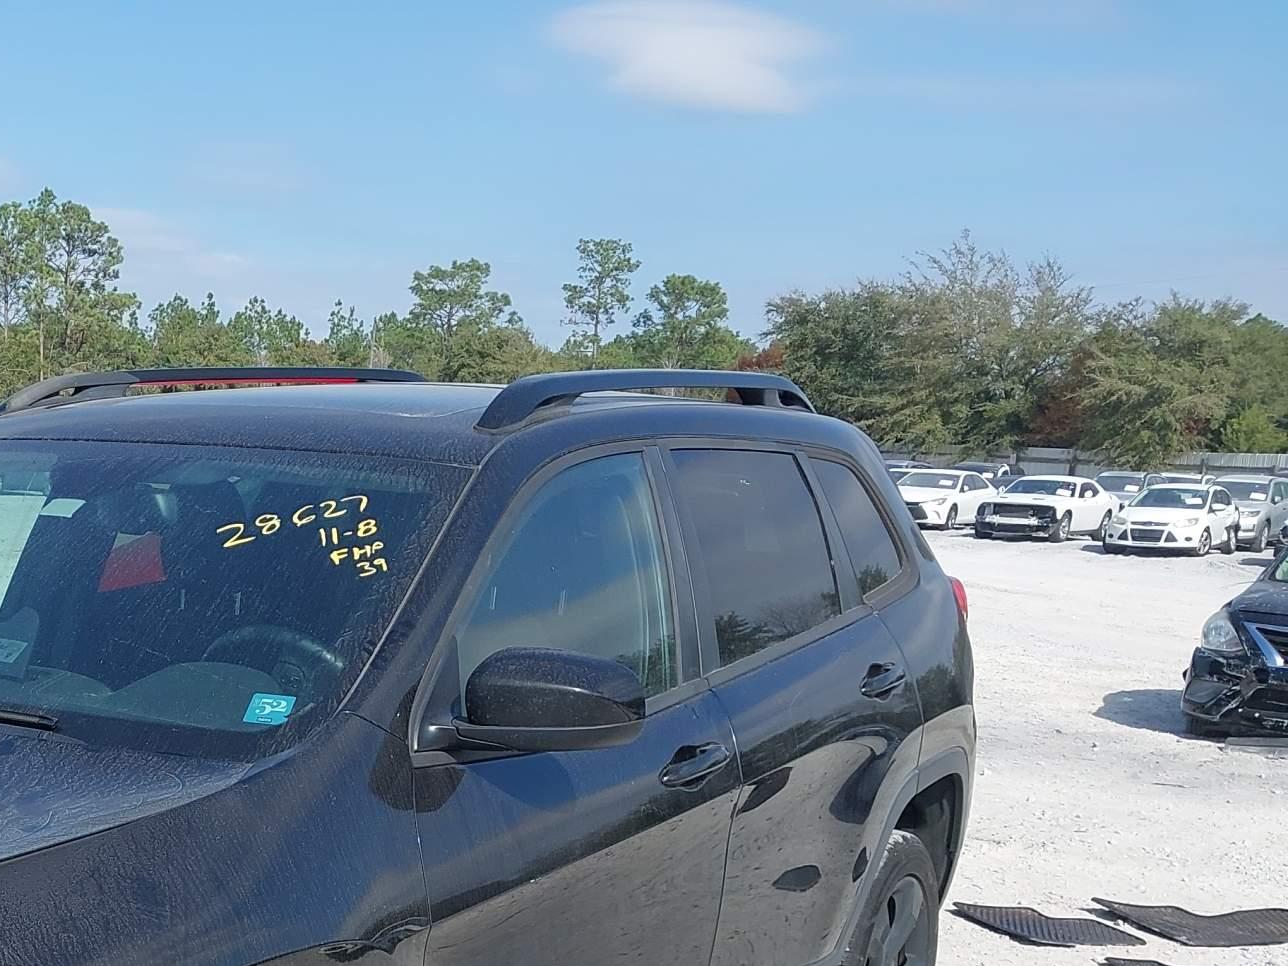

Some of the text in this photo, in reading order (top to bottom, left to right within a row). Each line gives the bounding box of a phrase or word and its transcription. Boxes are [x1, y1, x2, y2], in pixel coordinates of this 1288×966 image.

[216, 495, 368, 547] 28627
[319, 519, 377, 546] 11-8
[356, 558, 388, 577] 39
